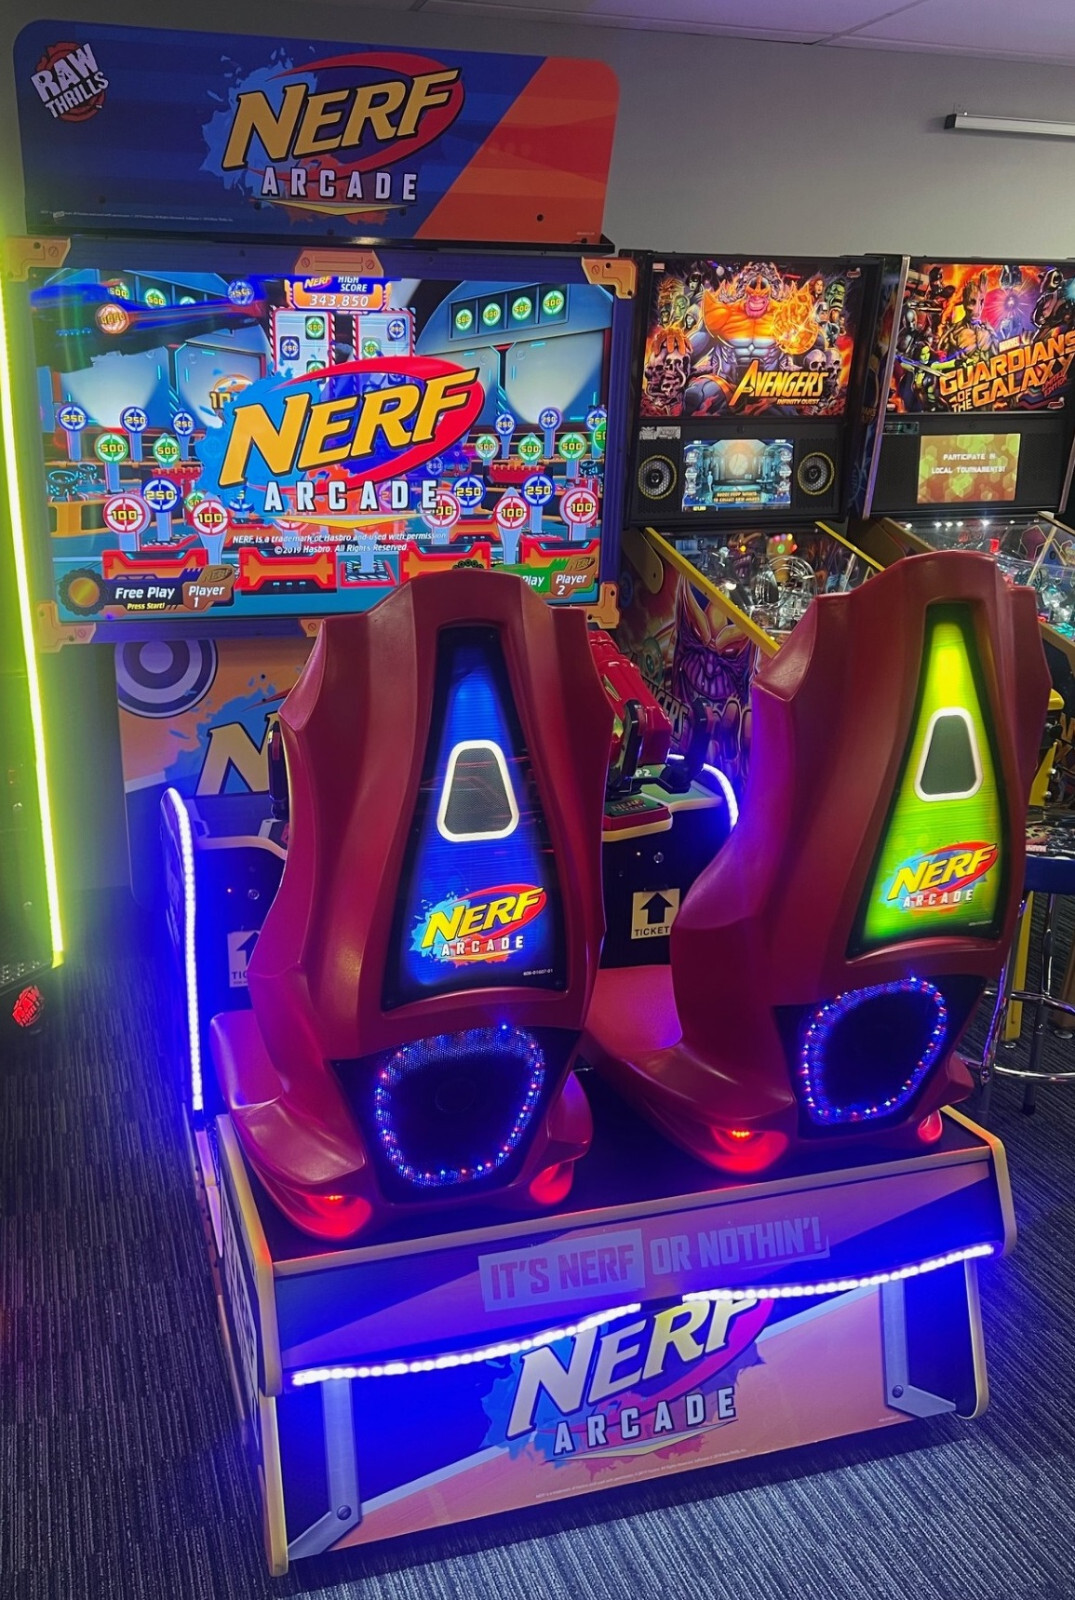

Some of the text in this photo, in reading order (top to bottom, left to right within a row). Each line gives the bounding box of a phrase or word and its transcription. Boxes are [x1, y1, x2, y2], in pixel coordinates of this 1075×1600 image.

[30, 43, 99, 102] RAW
[45, 71, 109, 118] THRILLS
[221, 68, 460, 169] NERF
[261, 166, 418, 201] ARCADE
[304, 276, 333, 289] NERF
[338, 276, 360, 284] HIGH
[340, 283, 369, 293] SCORE
[310, 294, 369, 308] 343,850
[939, 330, 1075, 397] GUARDIANS
[728, 359, 830, 406] AVENGERS
[973, 353, 1075, 408] GALAXY
[957, 388, 972, 403] OF
[951, 399, 974, 413] THE
[62, 413, 85, 423] 250
[123, 415, 146, 425] 250
[173, 419, 194, 429] 250
[218, 367, 481, 488] NERF
[100, 443, 125, 454] 500
[157, 445, 178, 456] 500
[521, 445, 539, 453] 500
[562, 443, 582, 451] 500
[943, 453, 986, 461] PARTICIPATE
[931, 466, 953, 474] LOCAL
[145, 489, 175, 501] 250
[263, 479, 439, 512] ARCADE
[456, 486, 482, 498] 250
[526, 485, 552, 496] 250
[502, 508, 524, 519] 100
[572, 502, 594, 513] 100
[110, 510, 137, 521] 100
[197, 513, 223, 524] 100
[232, 535, 254, 544] NERF
[255, 535, 262, 544] is
[388, 532, 406, 541] with
[334, 544, 345, 553] All
[555, 574, 588, 586] Player
[115, 586, 175, 600] Free Play
[188, 585, 226, 598] Player
[556, 585, 566, 596] 2
[127, 602, 166, 611] Press Start!
[193, 597, 199, 608] 1
[635, 768, 652, 778] P2
[886, 843, 998, 901] NERF
[902, 888, 974, 908] ARCADE
[421, 887, 545, 949] NERF
[634, 924, 671, 937] TICKET
[440, 934, 525, 957] ARCADE
[490, 1216, 824, 1301] IT'S NERF OR NOTHIN'!
[506, 1297, 758, 1438] NERF
[553, 1386, 736, 1455] ARCADE
